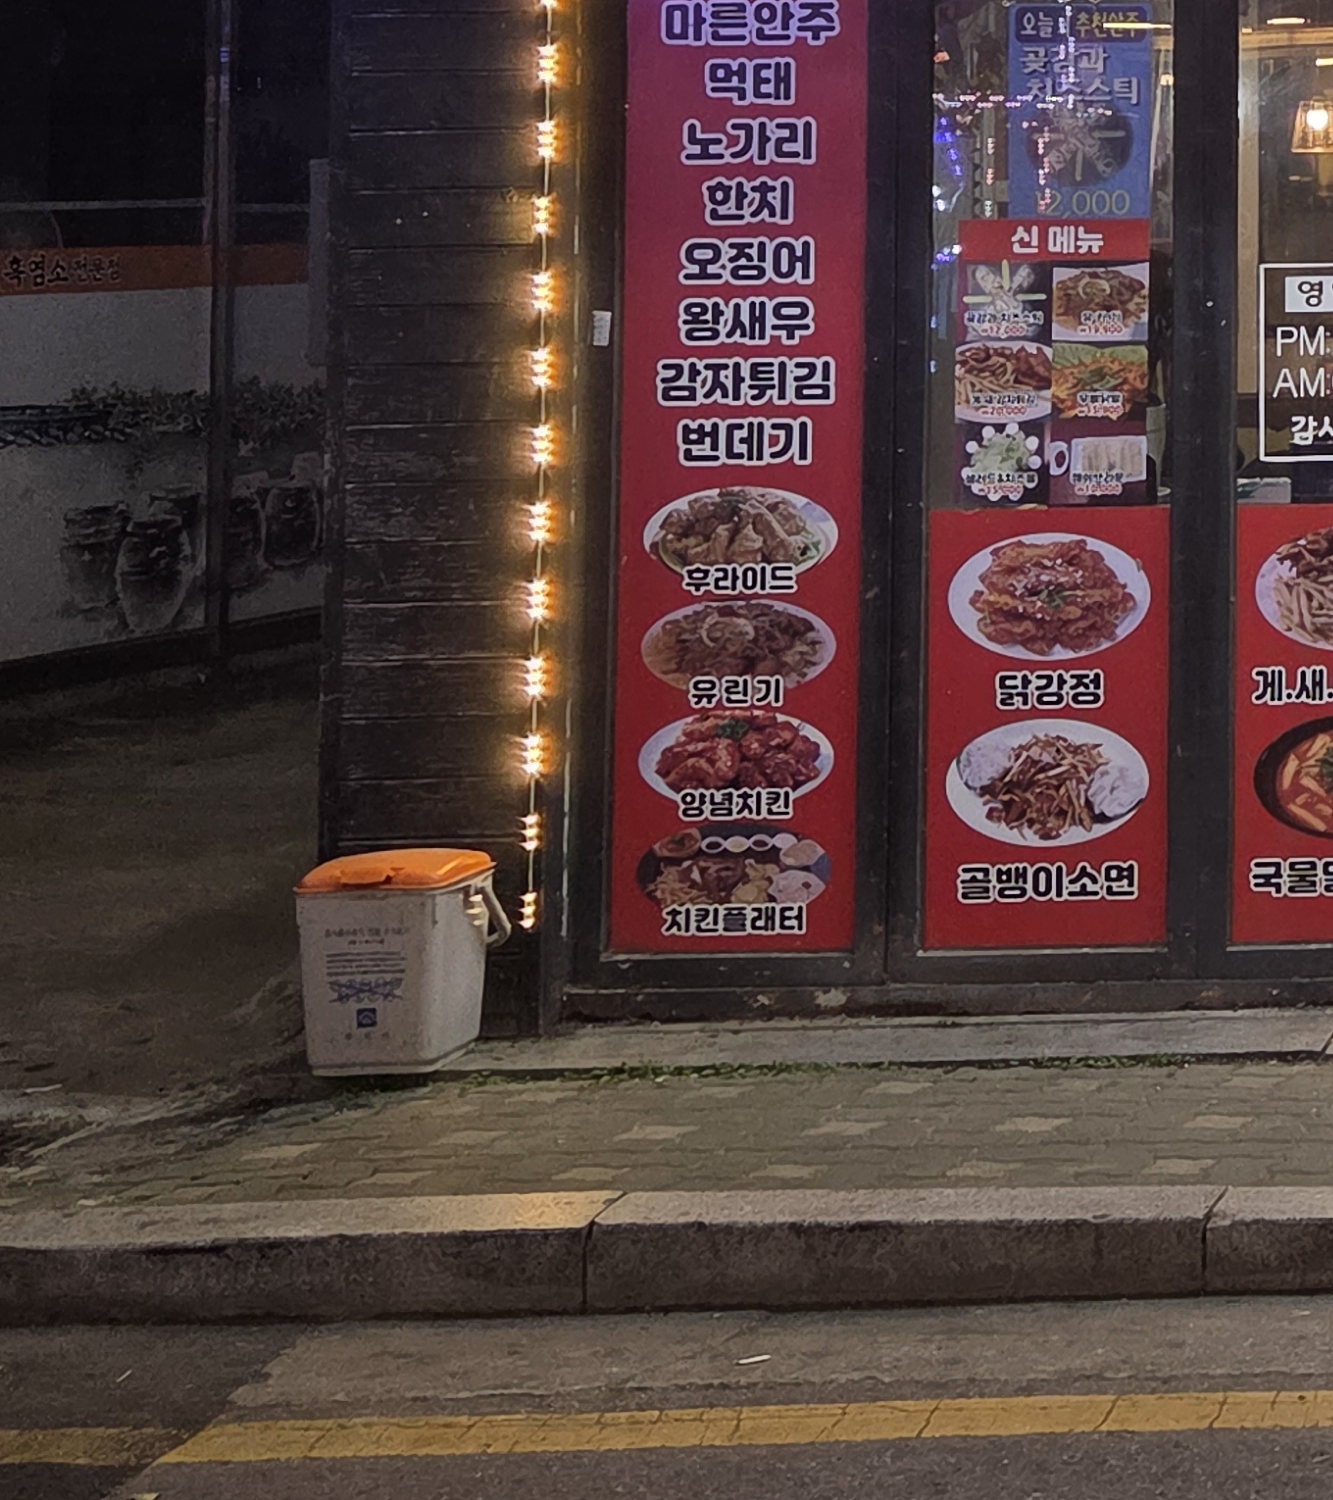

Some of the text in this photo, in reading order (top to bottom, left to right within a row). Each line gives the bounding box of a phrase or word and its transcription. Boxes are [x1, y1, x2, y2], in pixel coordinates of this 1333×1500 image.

[705, 58, 796, 106] 먹태
[681, 116, 817, 166] 노가리
[703, 177, 794, 226] 한치
[679, 237, 815, 286] 오징어
[1011, 224, 1104, 254] 신 메뉴
[679, 296, 815, 345] 왕새우
[657, 357, 836, 406] 감자튀김
[678, 418, 813, 466] 번데기
[682, 563, 798, 594] 후라이드
[689, 676, 784, 708] 유린기
[995, 669, 1105, 709] 닭강정
[679, 789, 794, 821] 양념치킨
[956, 861, 1139, 904] 골뱅이소면
[661, 903, 807, 936] 치킨플래터
